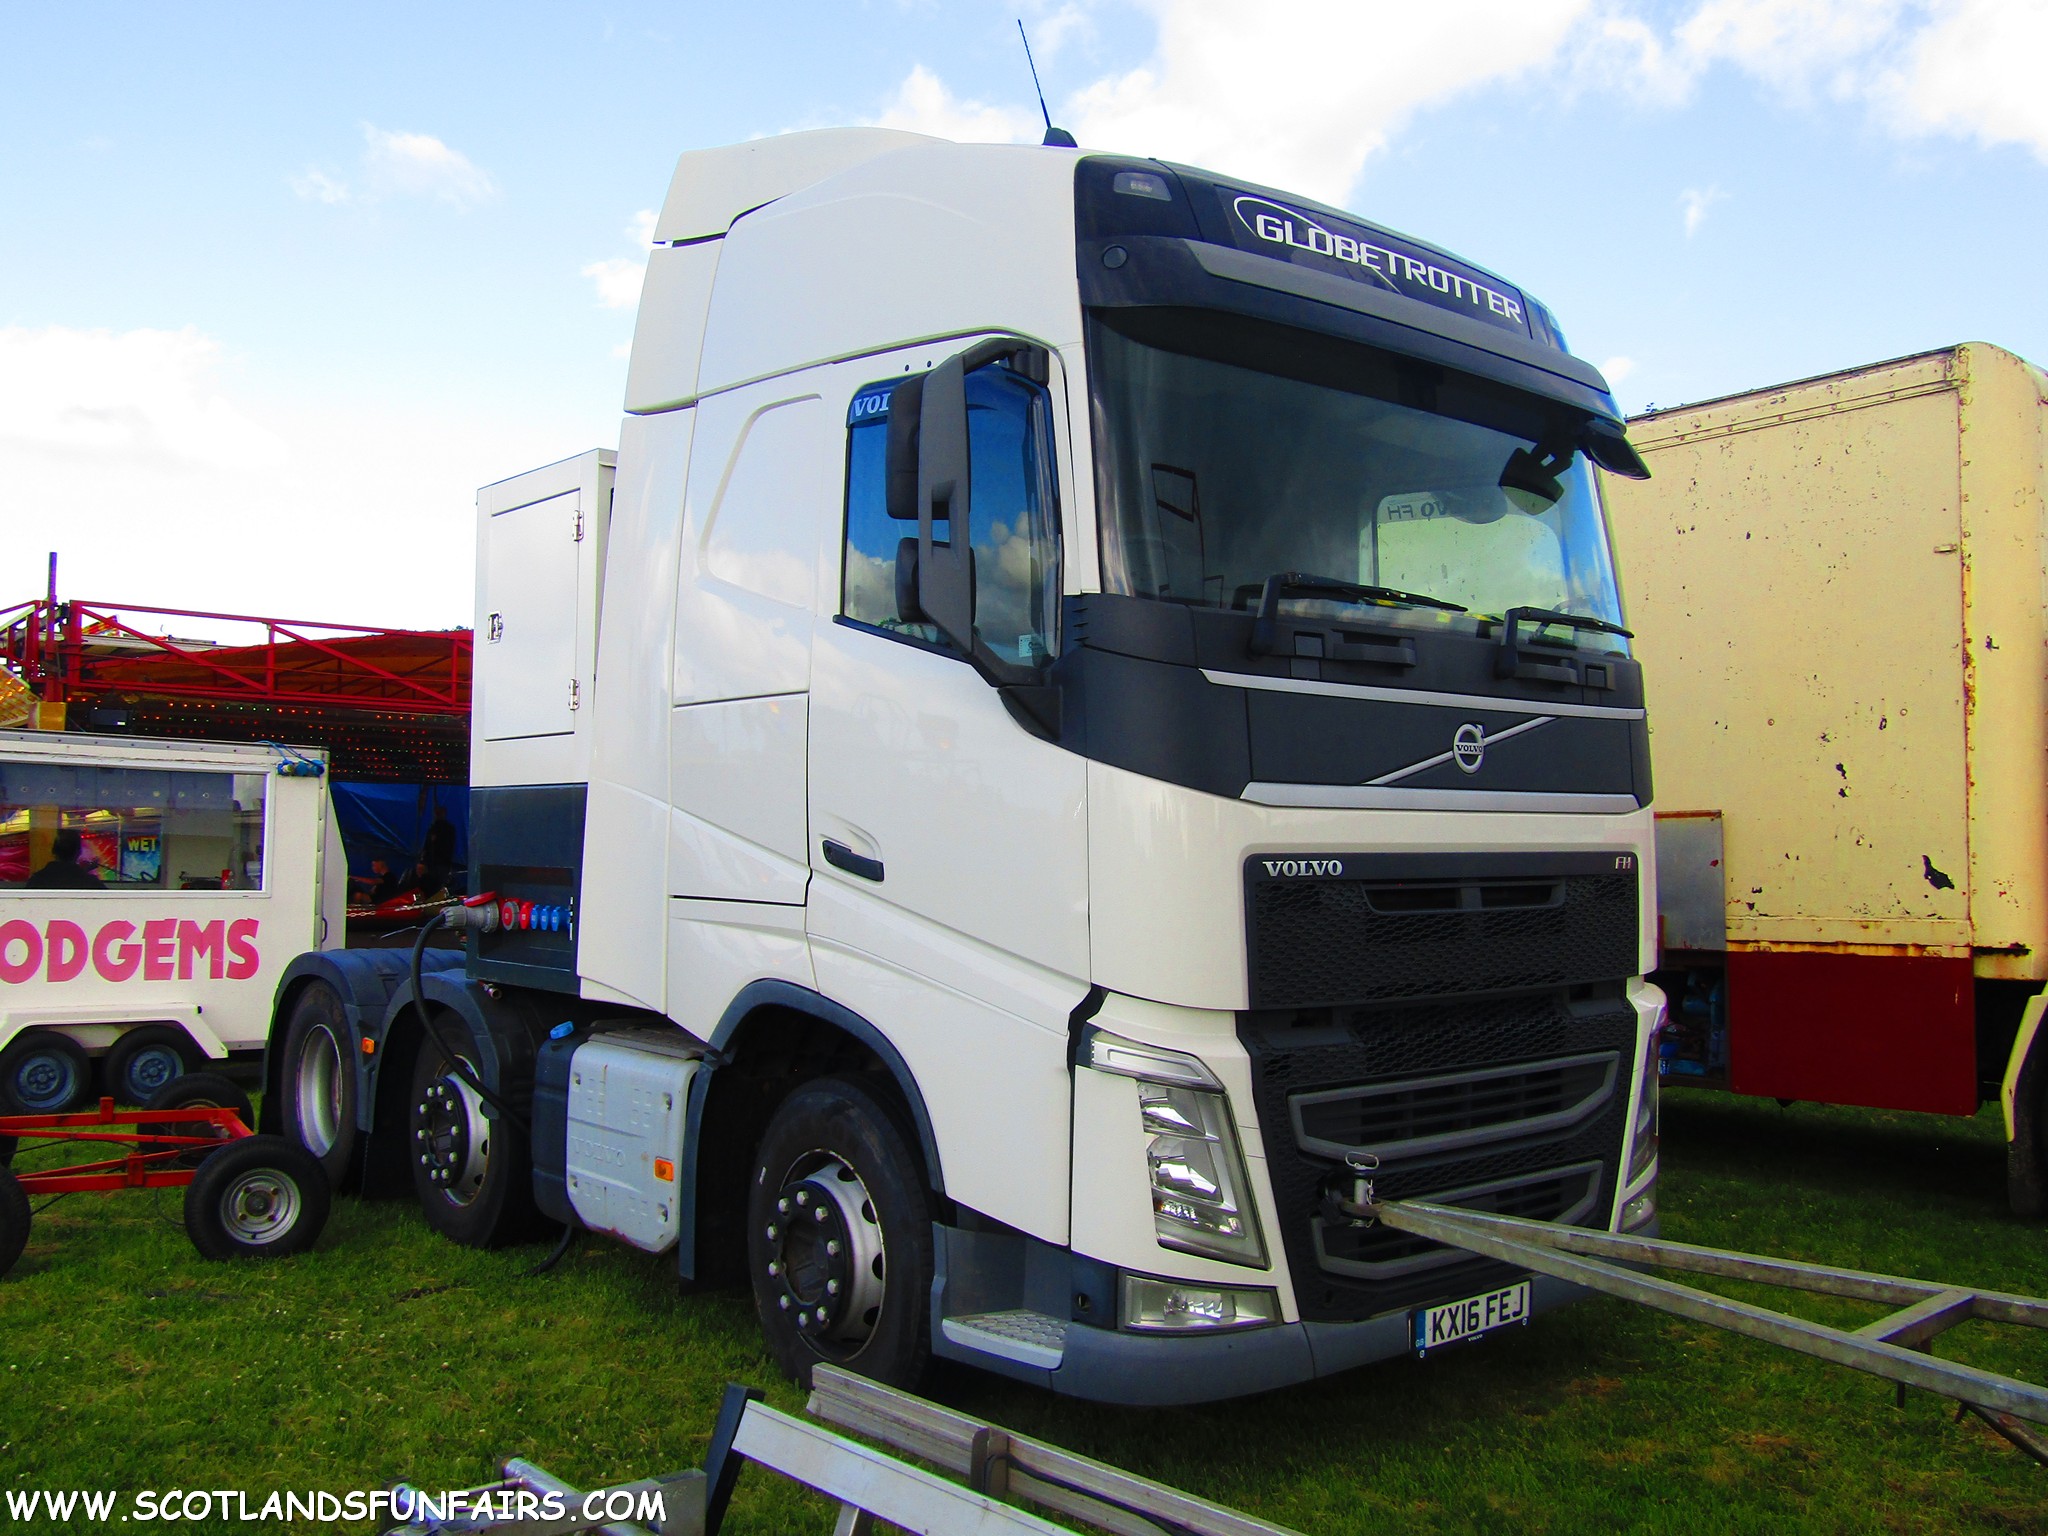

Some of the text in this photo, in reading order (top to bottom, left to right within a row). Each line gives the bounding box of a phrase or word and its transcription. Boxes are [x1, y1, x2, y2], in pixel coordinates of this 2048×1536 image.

[1255, 213, 1523, 325] GLOBETROTTER
[853, 392, 891, 417] VOL
[1456, 744, 1483, 753] VOLVO
[127, 836, 157, 852] WET
[1262, 860, 1343, 877] VOLVO
[0, 918, 260, 984] ODGEMS
[1431, 1286, 1524, 1343] KX16 FEJ
